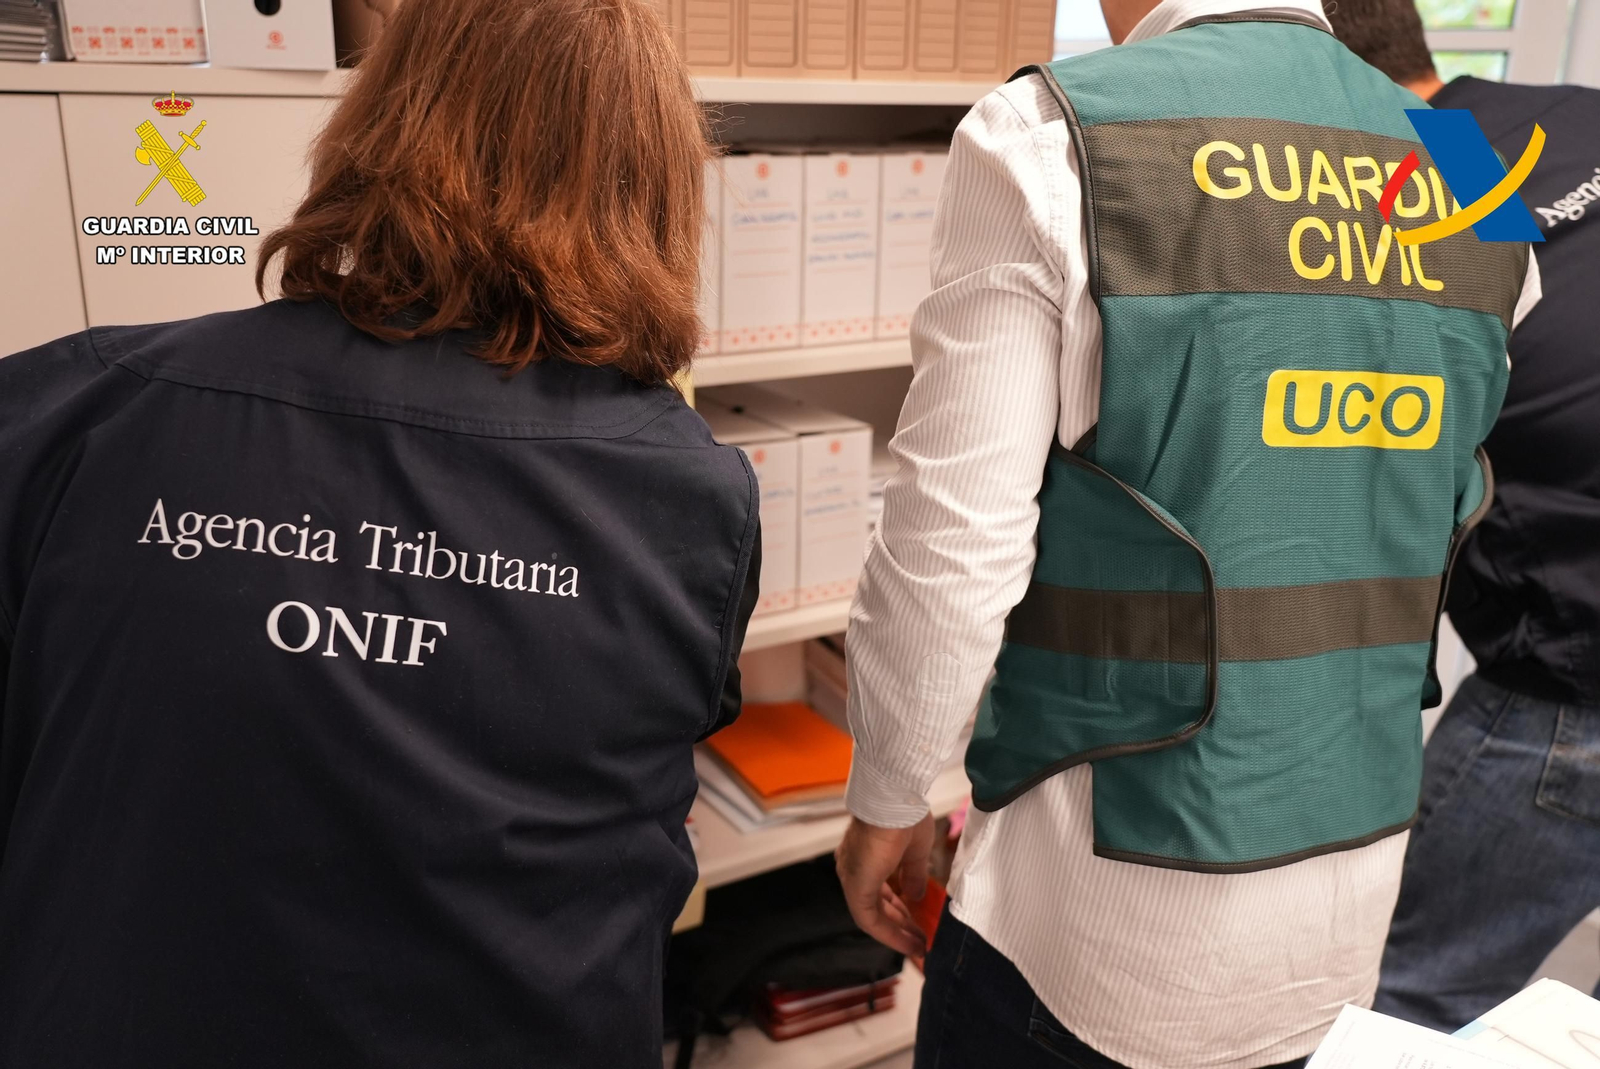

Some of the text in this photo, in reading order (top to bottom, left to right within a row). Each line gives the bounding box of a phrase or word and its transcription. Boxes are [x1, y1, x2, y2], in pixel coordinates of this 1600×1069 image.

[1193, 141, 1462, 219] GUARDI
[1283, 381, 1431, 438] UCO
[138, 498, 580, 597] Agencia Tributaria
[266, 600, 448, 666] ONIF
